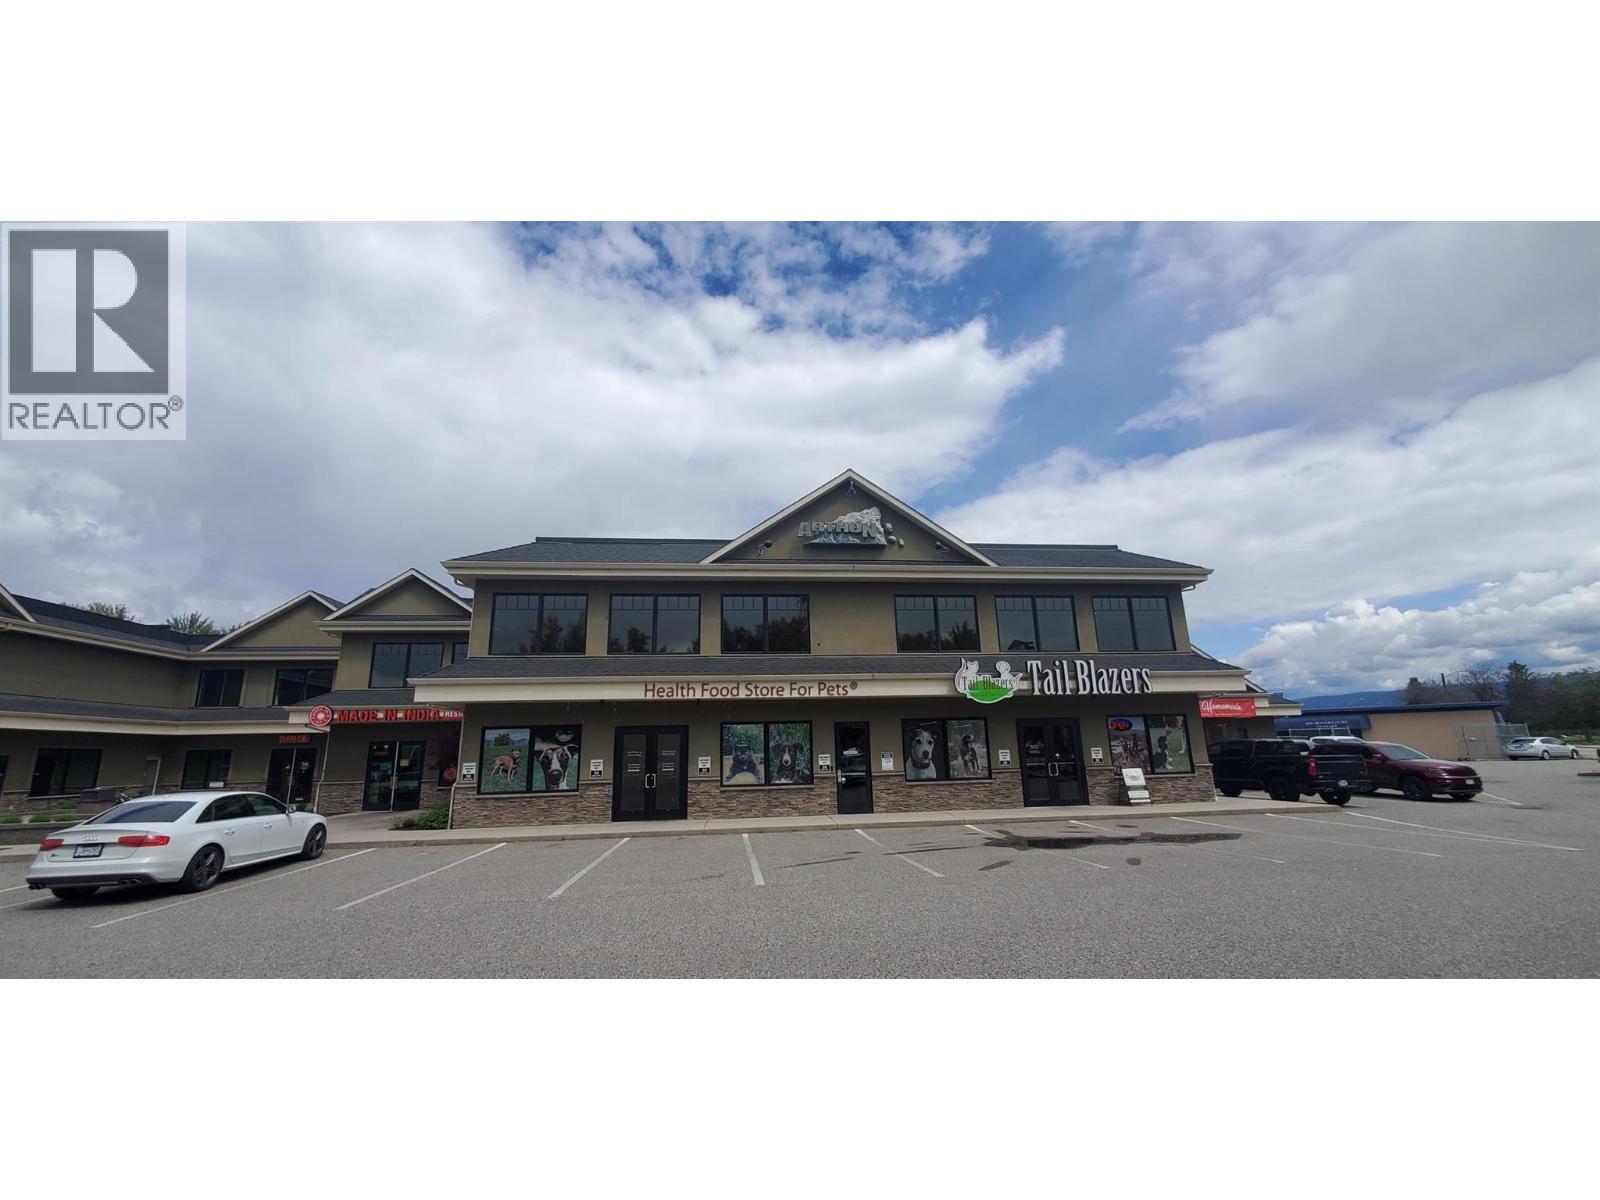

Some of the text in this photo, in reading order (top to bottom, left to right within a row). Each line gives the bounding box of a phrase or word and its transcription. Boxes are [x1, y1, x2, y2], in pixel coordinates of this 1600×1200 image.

[797, 521, 877, 538] ARTHON
[1026, 659, 1153, 695] Tail Blazers
[644, 682, 696, 698] Health
[701, 682, 740, 698] Food
[744, 682, 785, 697] Store
[789, 681, 813, 697] For
[336, 708, 378, 722] MADE
[382, 708, 398, 721] IN
[403, 707, 440, 721] INDIA
